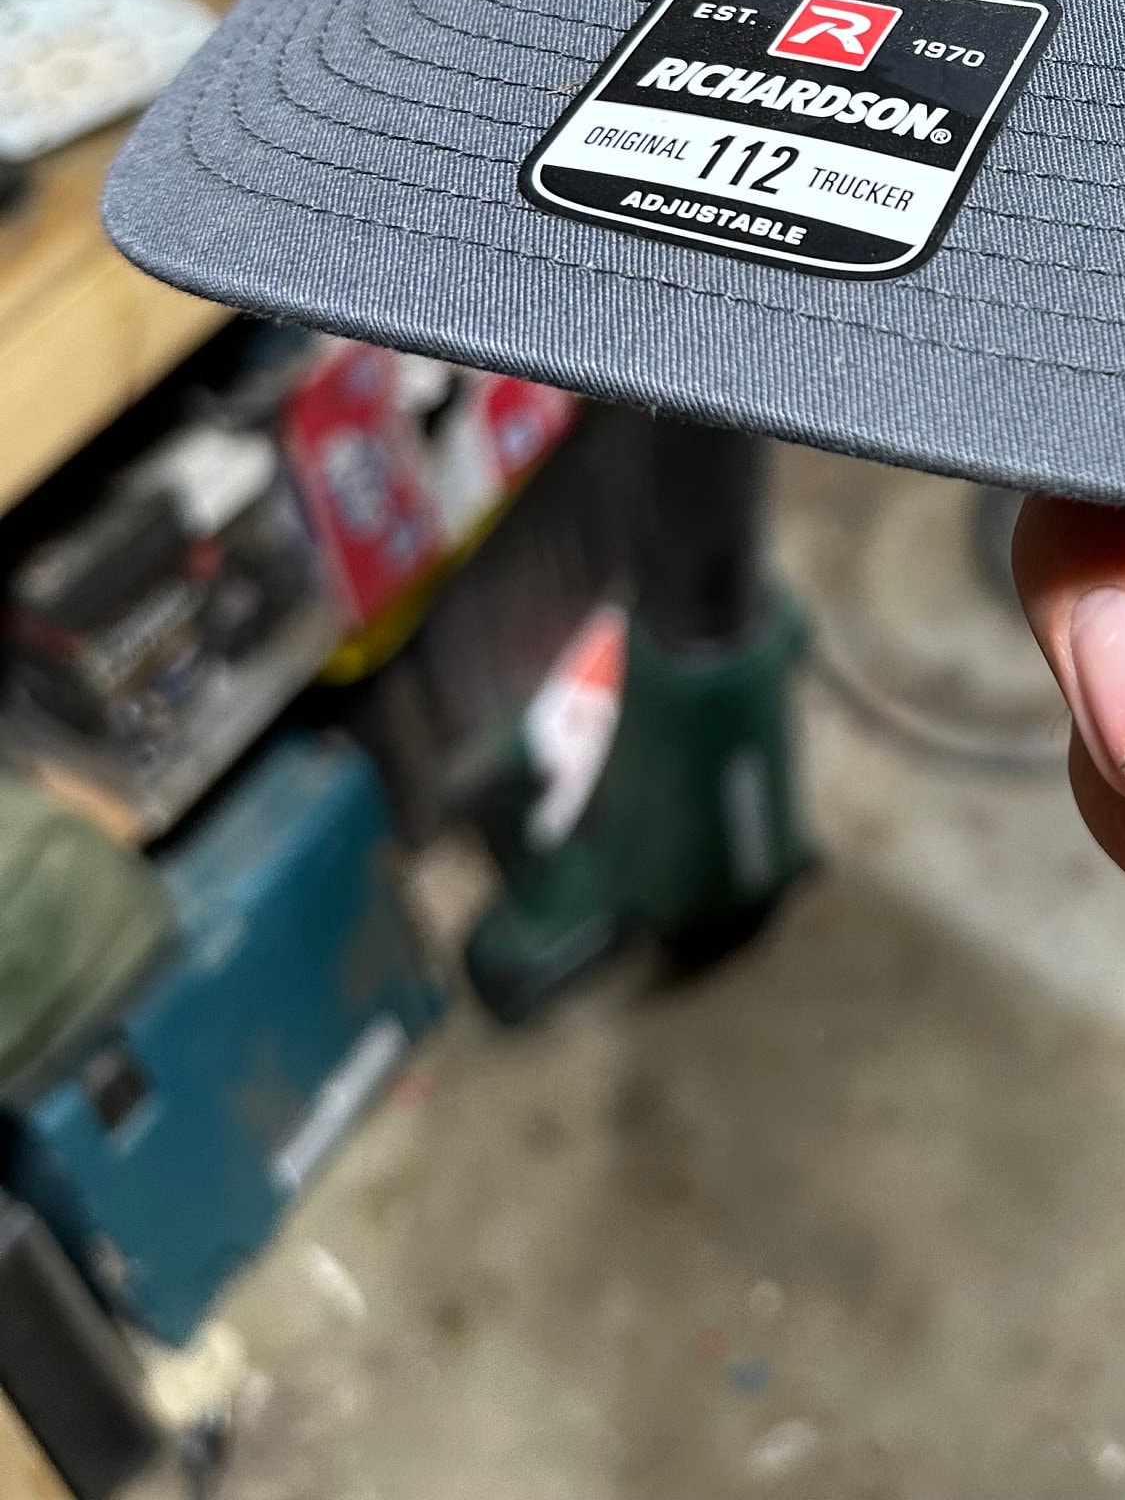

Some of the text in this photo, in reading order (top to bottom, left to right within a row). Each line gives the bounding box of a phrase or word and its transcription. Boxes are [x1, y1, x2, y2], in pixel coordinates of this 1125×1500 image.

[693, 2, 986, 69] EST. 1970
[584, 126, 916, 213] ORIGINAL 112 TRUCKER
[620, 190, 808, 246] ADJUSTABLE
